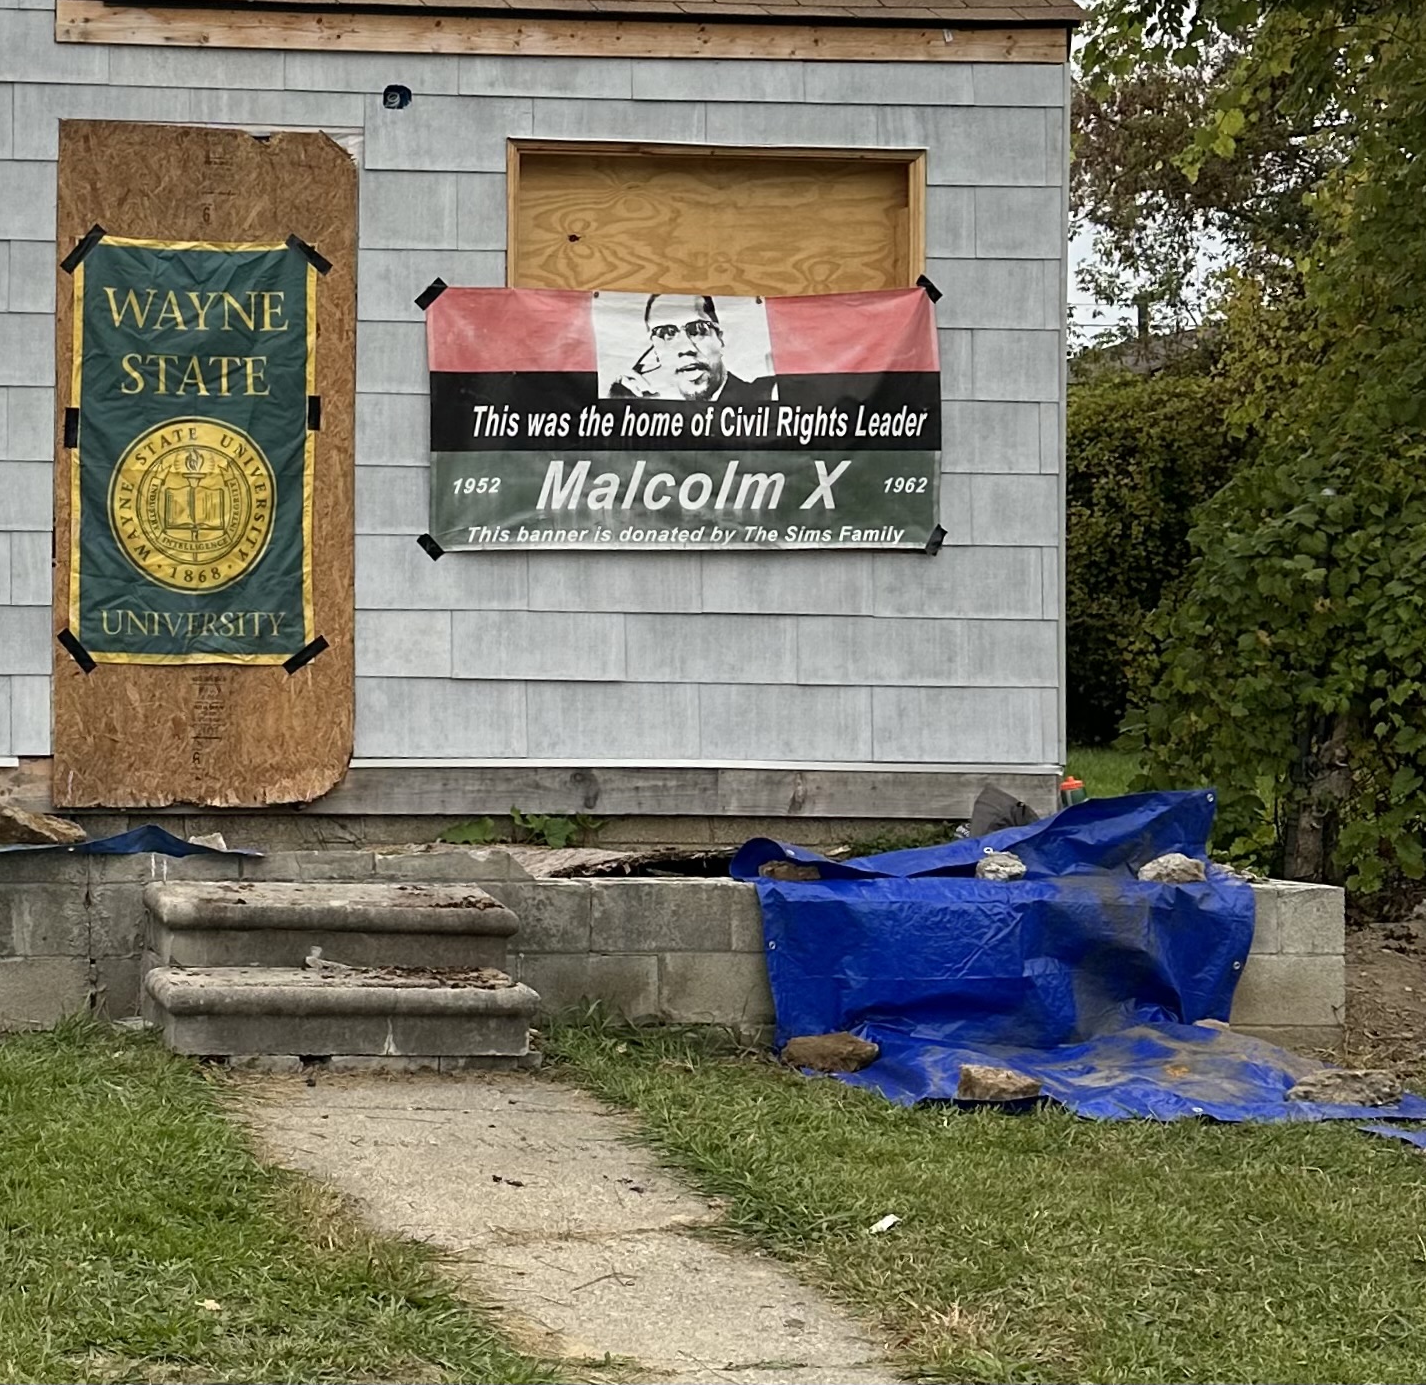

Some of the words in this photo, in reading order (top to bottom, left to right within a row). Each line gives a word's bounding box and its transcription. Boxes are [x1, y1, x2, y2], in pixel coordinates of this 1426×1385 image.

[102, 286, 289, 332] WAYNE
[120, 353, 271, 397] STATE
[473, 404, 520, 438] This
[527, 412, 571, 437] was
[578, 404, 614, 437] the
[620, 404, 684, 437] home
[690, 406, 715, 437] of
[720, 405, 770, 437] Civil
[776, 405, 849, 445] Rights
[854, 404, 928, 437] Leader
[135, 427, 198, 466] STATE
[219, 433, 268, 563] UNIVERSITY
[452, 477, 502, 495] 1952
[535, 460, 786, 511] Malcolm
[799, 460, 853, 510] X
[883, 477, 928, 494] 1962
[119, 482, 152, 563] WAYNE
[467, 525, 511, 543] This
[516, 525, 589, 543] banner
[594, 525, 612, 543] is
[619, 525, 705, 543] donated
[709, 525, 737, 546] by
[744, 525, 779, 542] The
[784, 525, 832, 542] Sims
[839, 525, 905, 545] Family
[162, 536, 228, 551] INTELLIGENCE
[169, 566, 222, 584] 1868
[100, 609, 286, 637] UNIVERSITY
